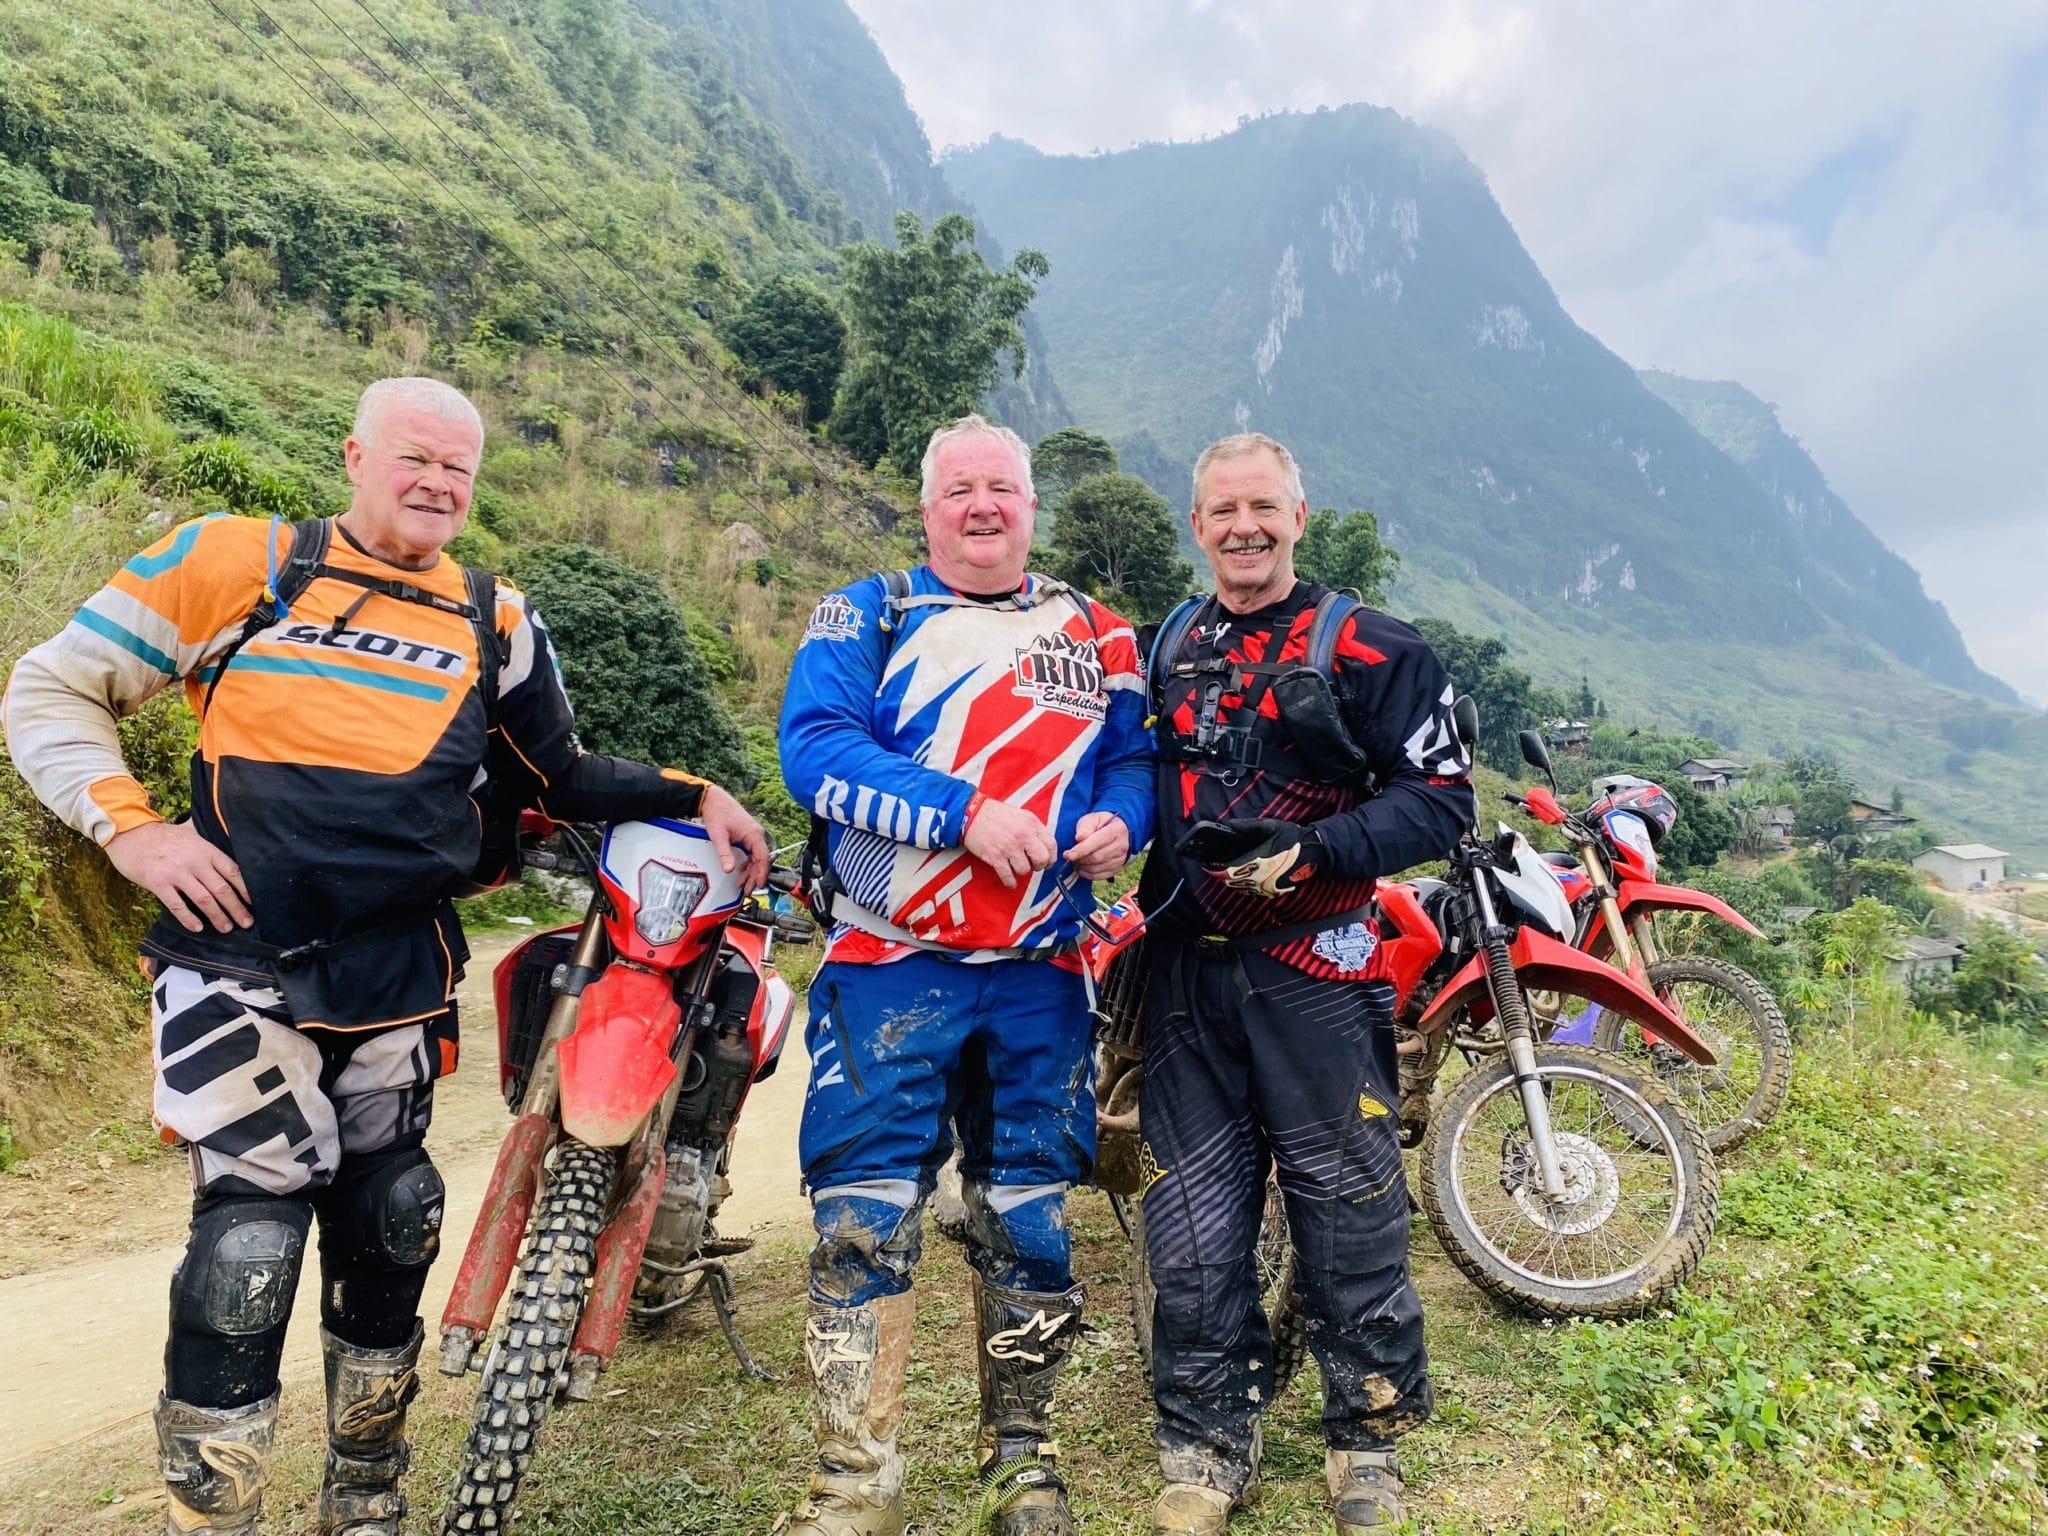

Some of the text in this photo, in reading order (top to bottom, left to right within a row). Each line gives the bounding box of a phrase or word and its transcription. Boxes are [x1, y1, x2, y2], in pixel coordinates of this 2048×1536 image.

[277, 625, 461, 670] SCOTT
[815, 774, 947, 850] RIDE
[661, 855, 698, 869] HONDA
